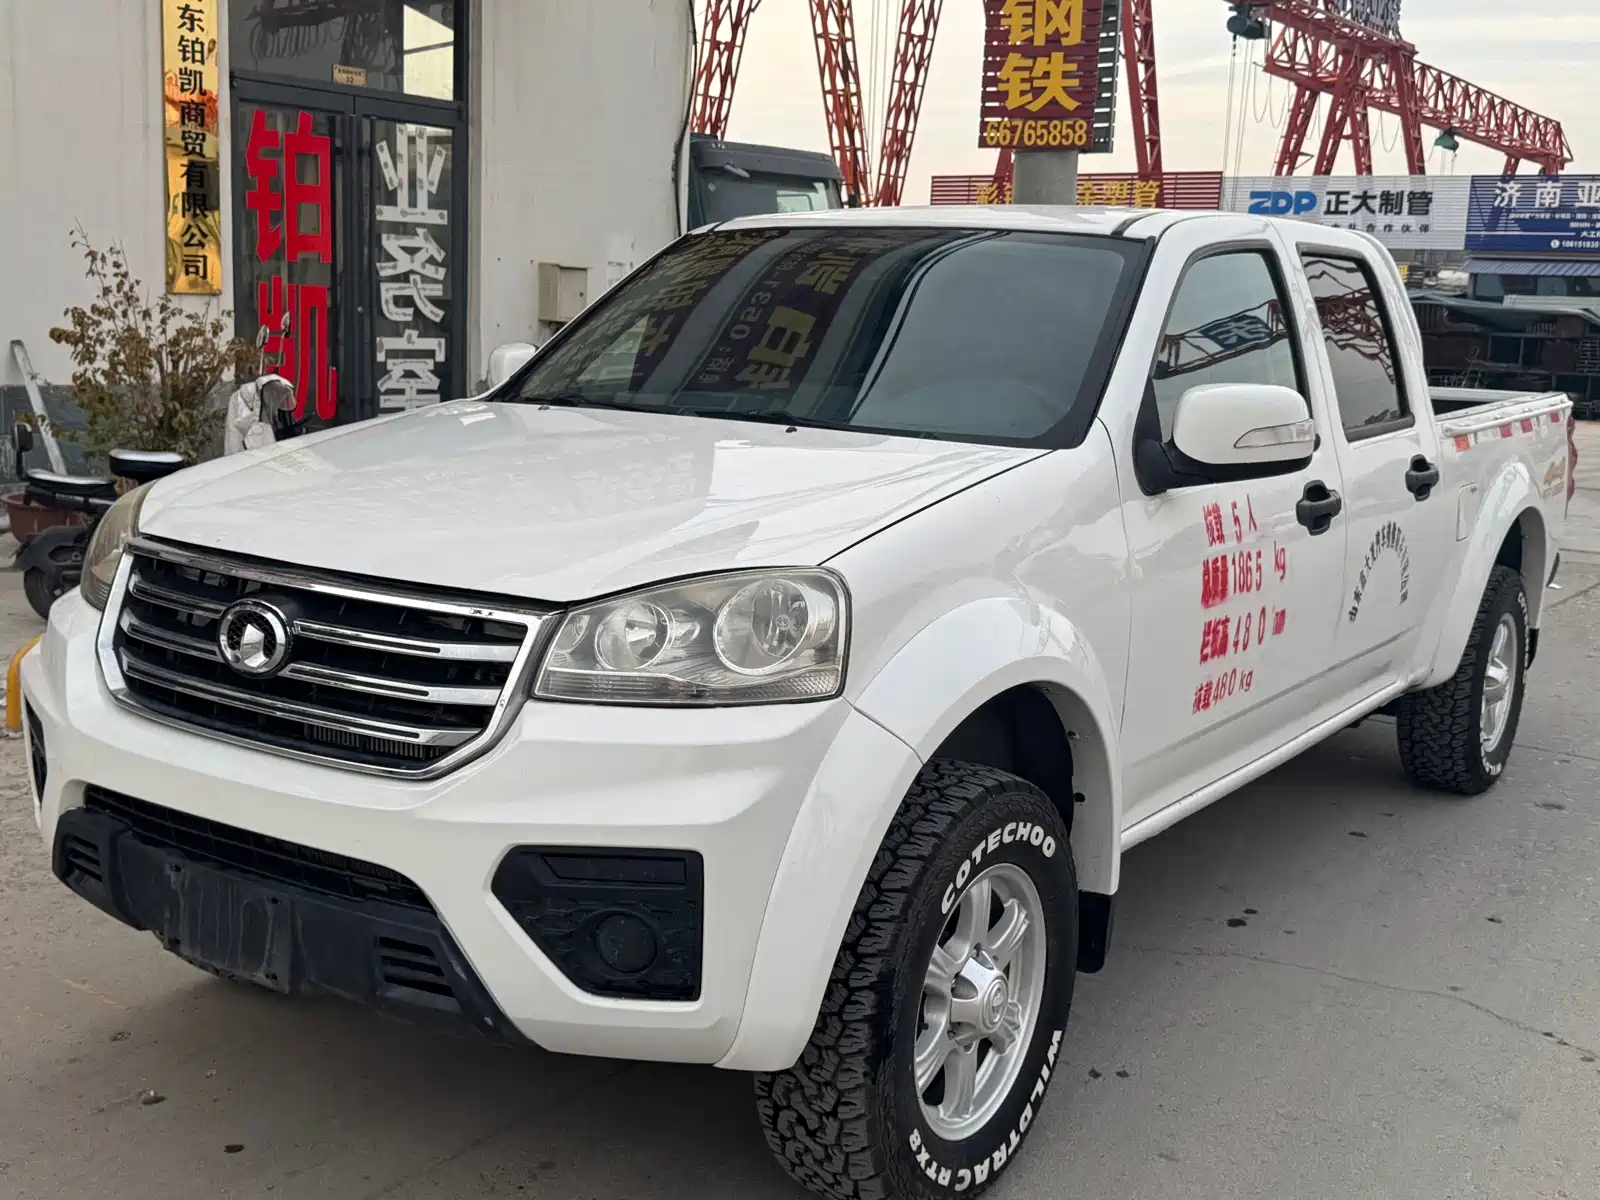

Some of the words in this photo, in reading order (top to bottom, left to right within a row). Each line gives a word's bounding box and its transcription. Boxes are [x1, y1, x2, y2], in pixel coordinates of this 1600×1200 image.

[176, 0, 208, 280] 东铂凯商贸有限公司
[985, 119, 1088, 146] 66765858
[1248, 191, 1317, 215] ZDP
[1323, 190, 1433, 216] 正大制管
[246, 108, 338, 420] 铂凯
[375, 122, 448, 416] 业务室
[941, 821, 1056, 915] COTECHOO
[954, 1030, 1063, 1191] WILDTRAC
